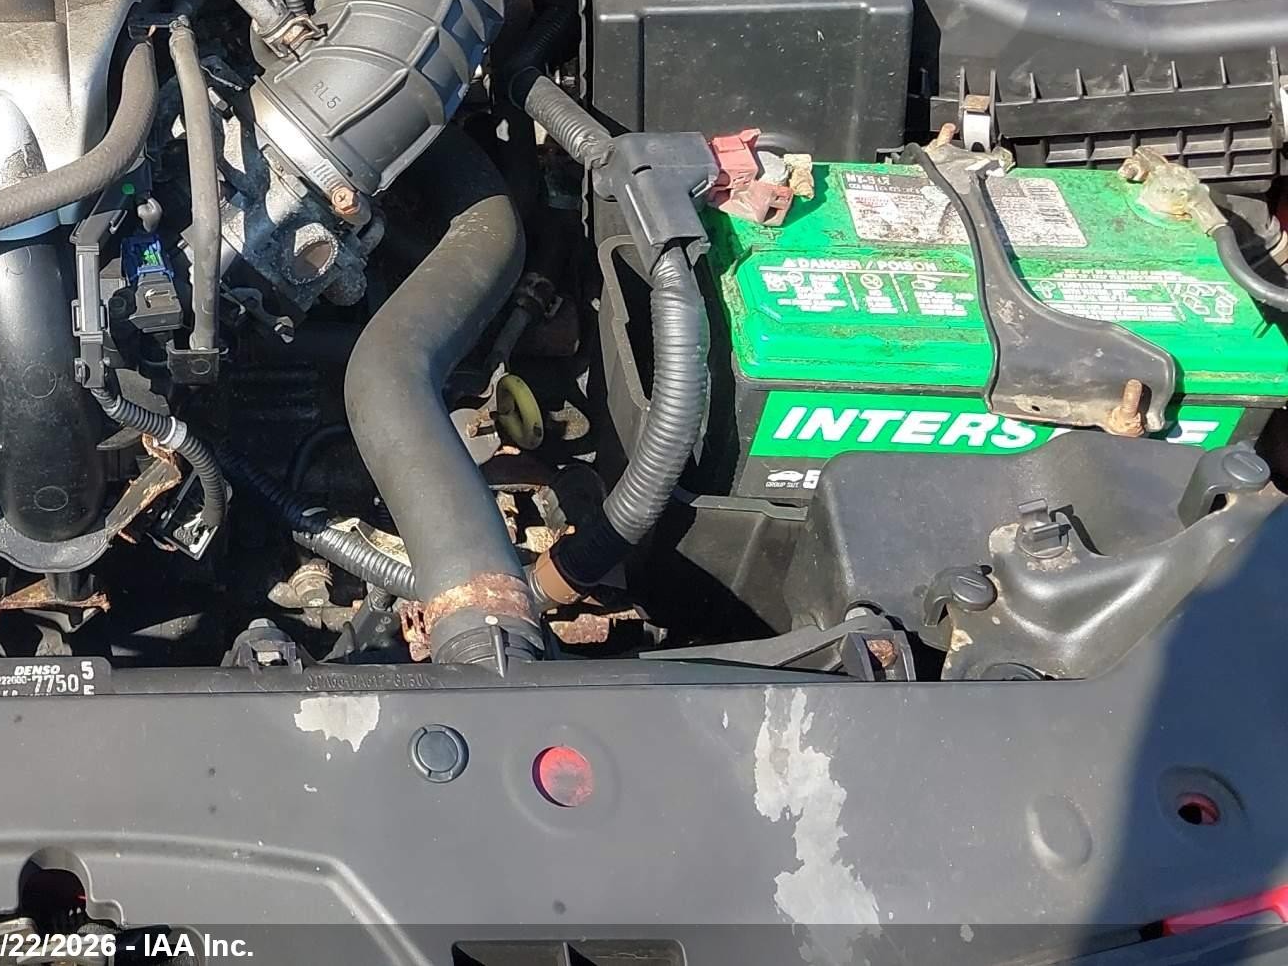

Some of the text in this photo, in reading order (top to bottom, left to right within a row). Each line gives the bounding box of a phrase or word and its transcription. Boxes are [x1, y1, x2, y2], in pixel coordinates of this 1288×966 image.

[798, 259, 862, 269] DANGER
[876, 260, 938, 271] POISON
[14, 664, 61, 675] DENSO
[81, 660, 94, 680] 5
